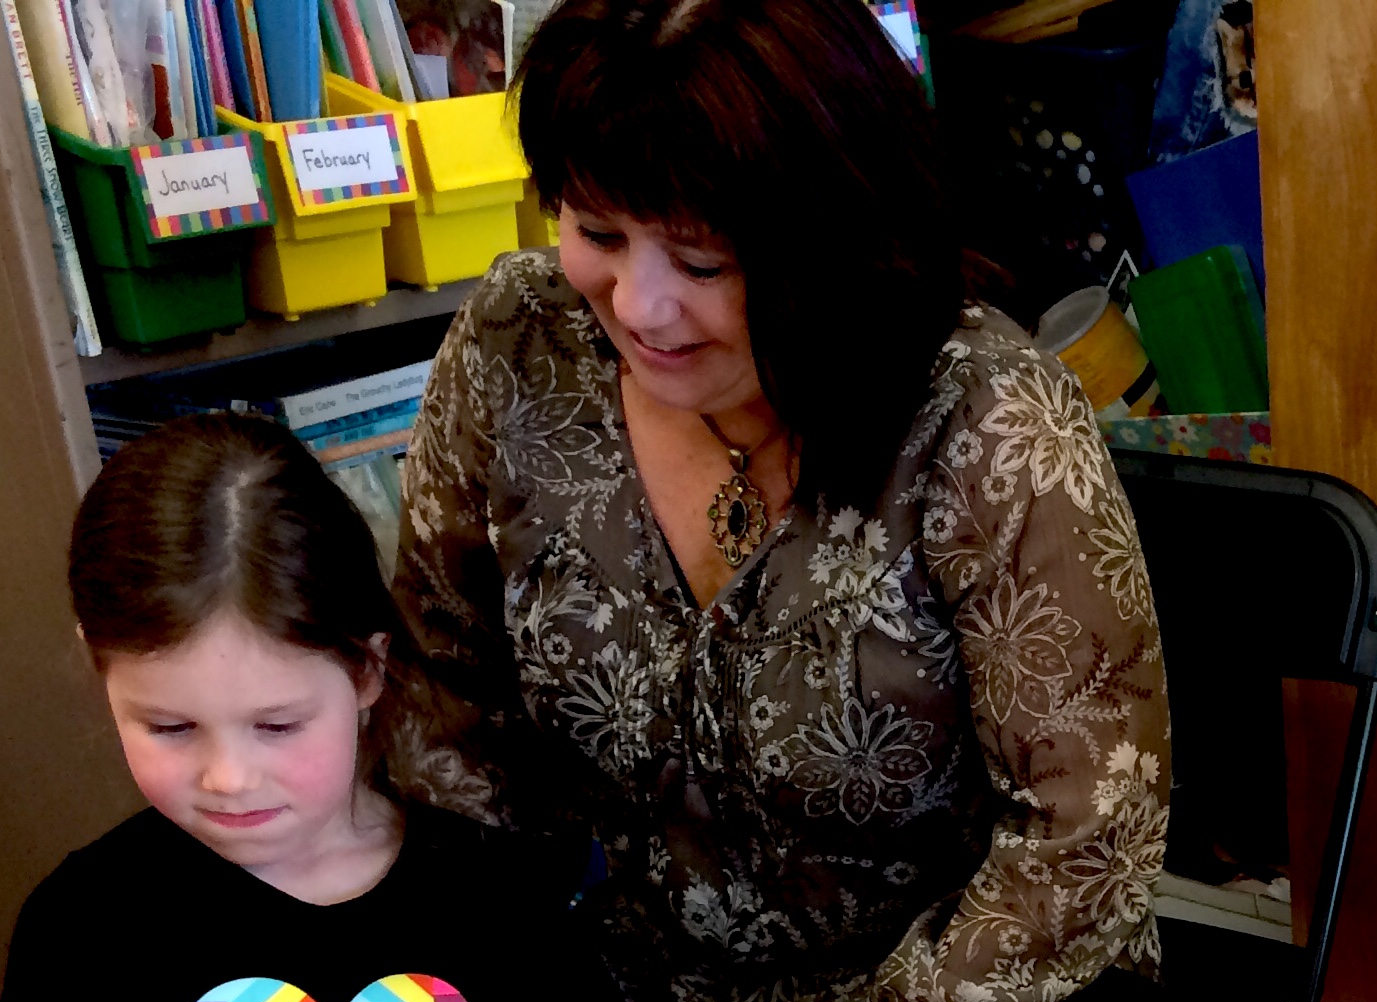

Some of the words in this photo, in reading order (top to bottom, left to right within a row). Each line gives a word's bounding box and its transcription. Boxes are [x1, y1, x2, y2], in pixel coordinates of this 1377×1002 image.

[6, 3, 17, 24] AN
[303, 148, 371, 172] February
[159, 171, 230, 196] January
